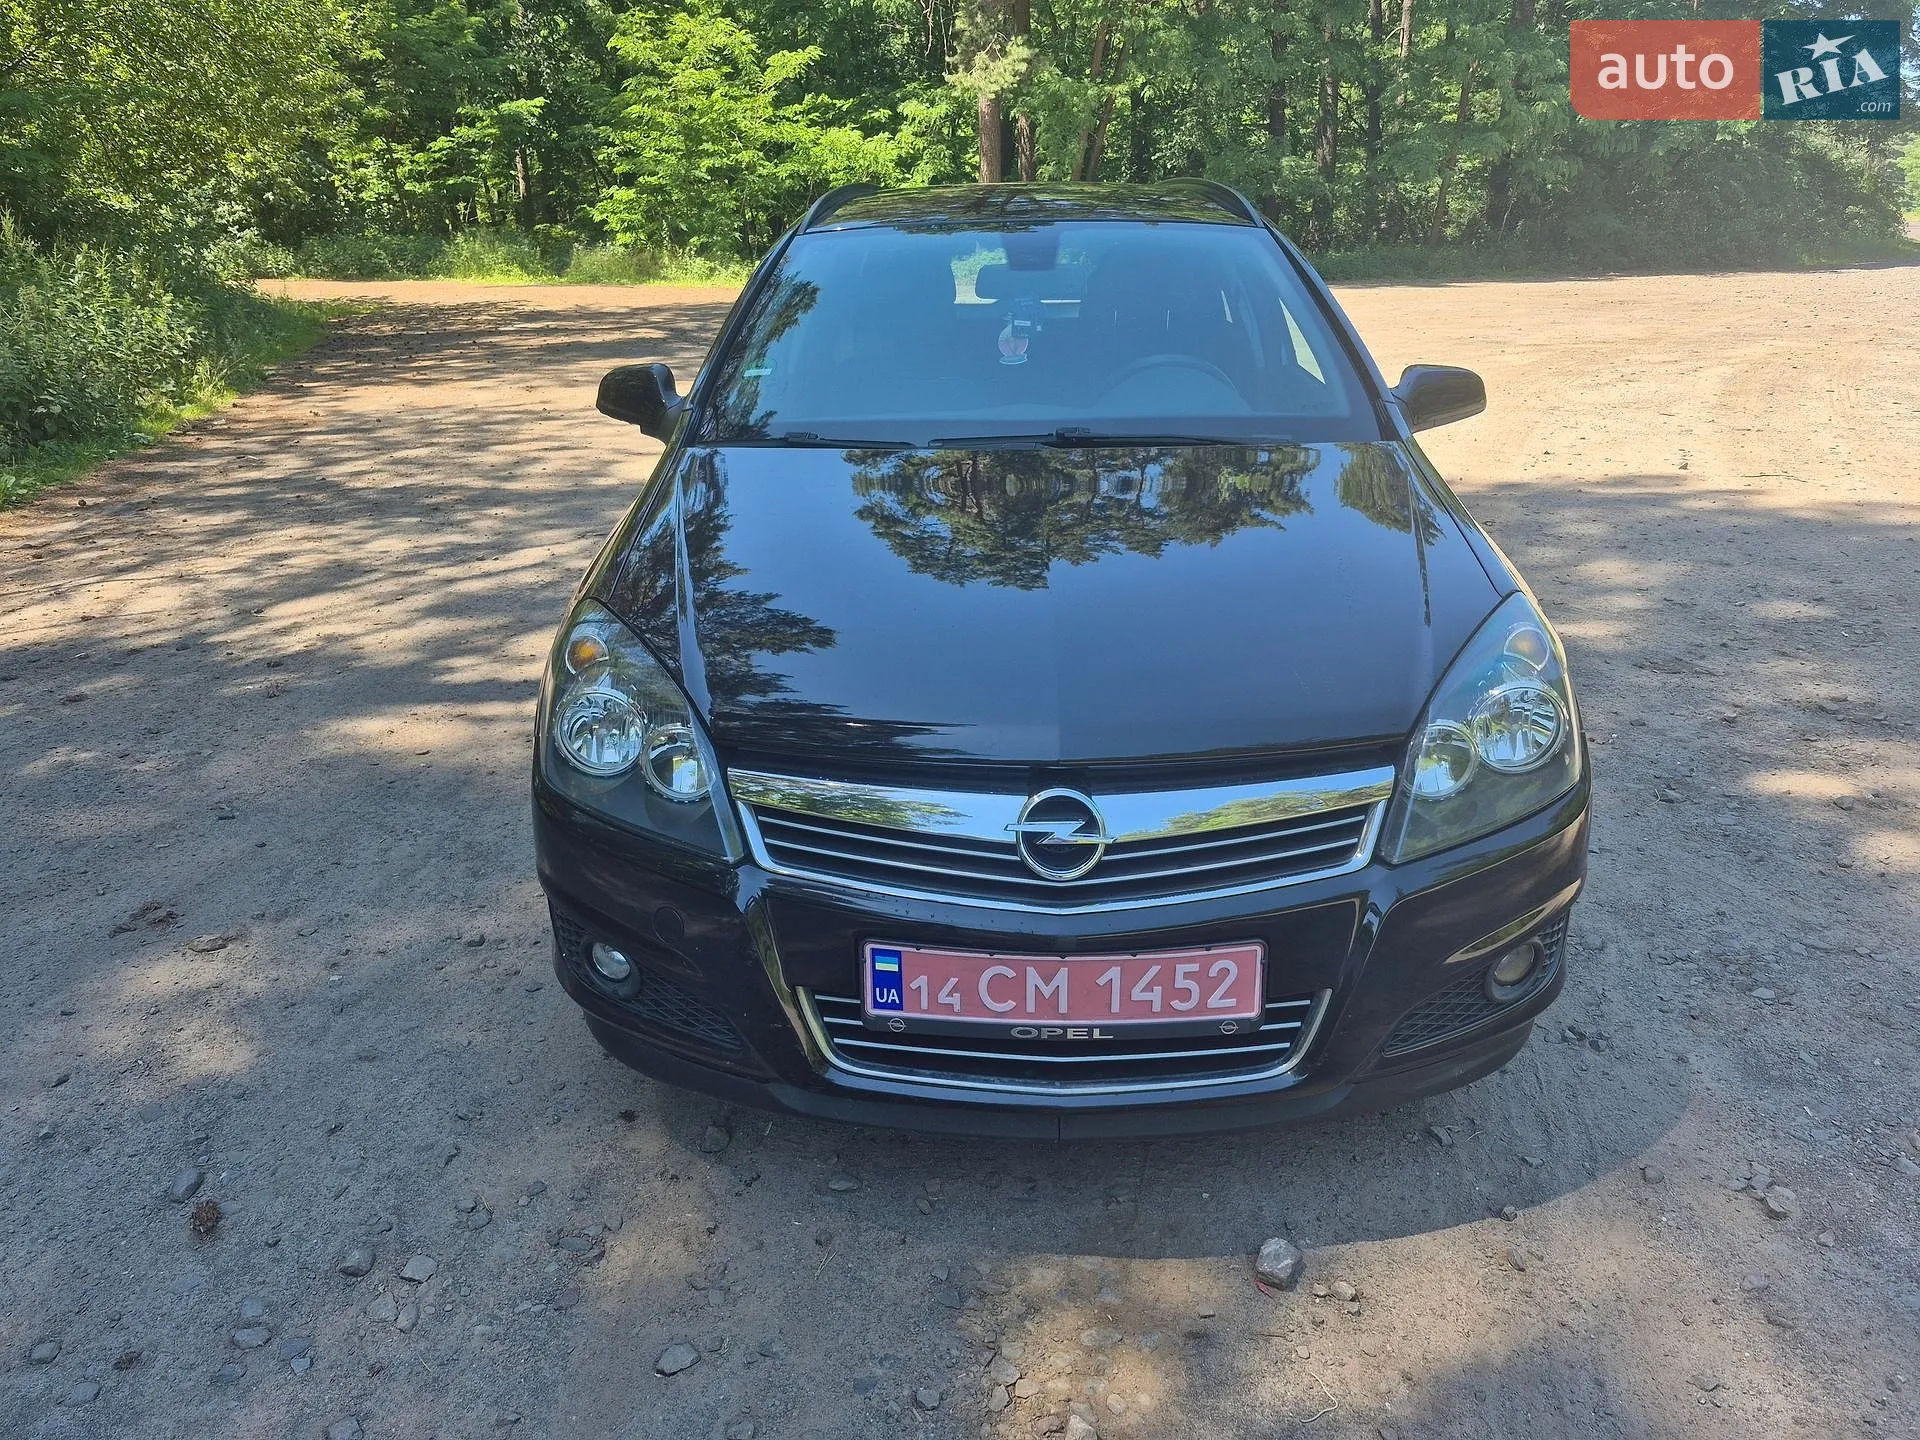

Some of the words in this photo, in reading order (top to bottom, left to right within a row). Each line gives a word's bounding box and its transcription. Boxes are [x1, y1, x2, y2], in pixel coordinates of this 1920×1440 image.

[909, 975, 961, 1013] 14
[978, 965, 1069, 1014] CM
[1095, 959, 1239, 1013] 1452
[876, 988, 900, 1005] UA
[1011, 1026, 1115, 1040] OPEL
